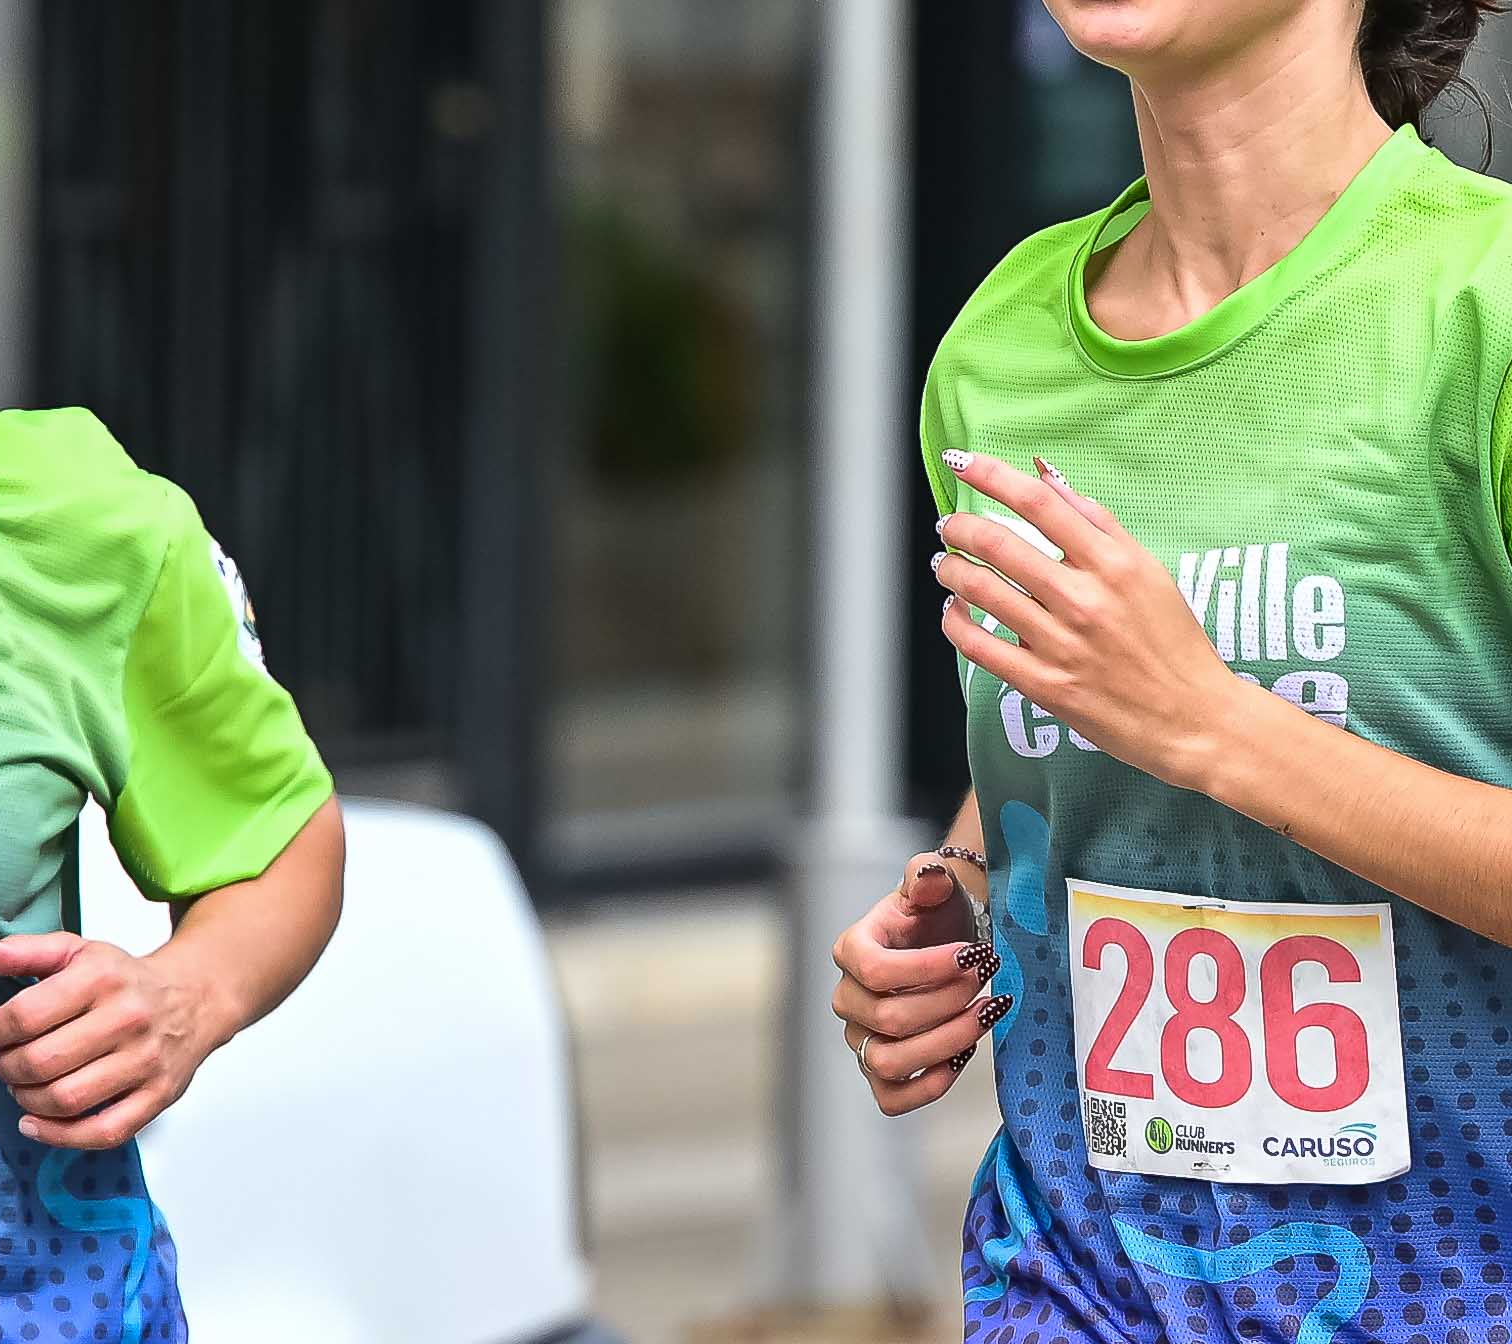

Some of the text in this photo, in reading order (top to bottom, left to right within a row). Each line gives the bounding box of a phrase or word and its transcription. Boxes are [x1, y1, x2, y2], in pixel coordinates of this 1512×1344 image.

[1081, 916, 1371, 1113] 286
[1175, 1124, 1206, 1138] CLUB
[1175, 1139, 1236, 1155] RUNNER'S
[1262, 1136, 1375, 1158] CARUSO
